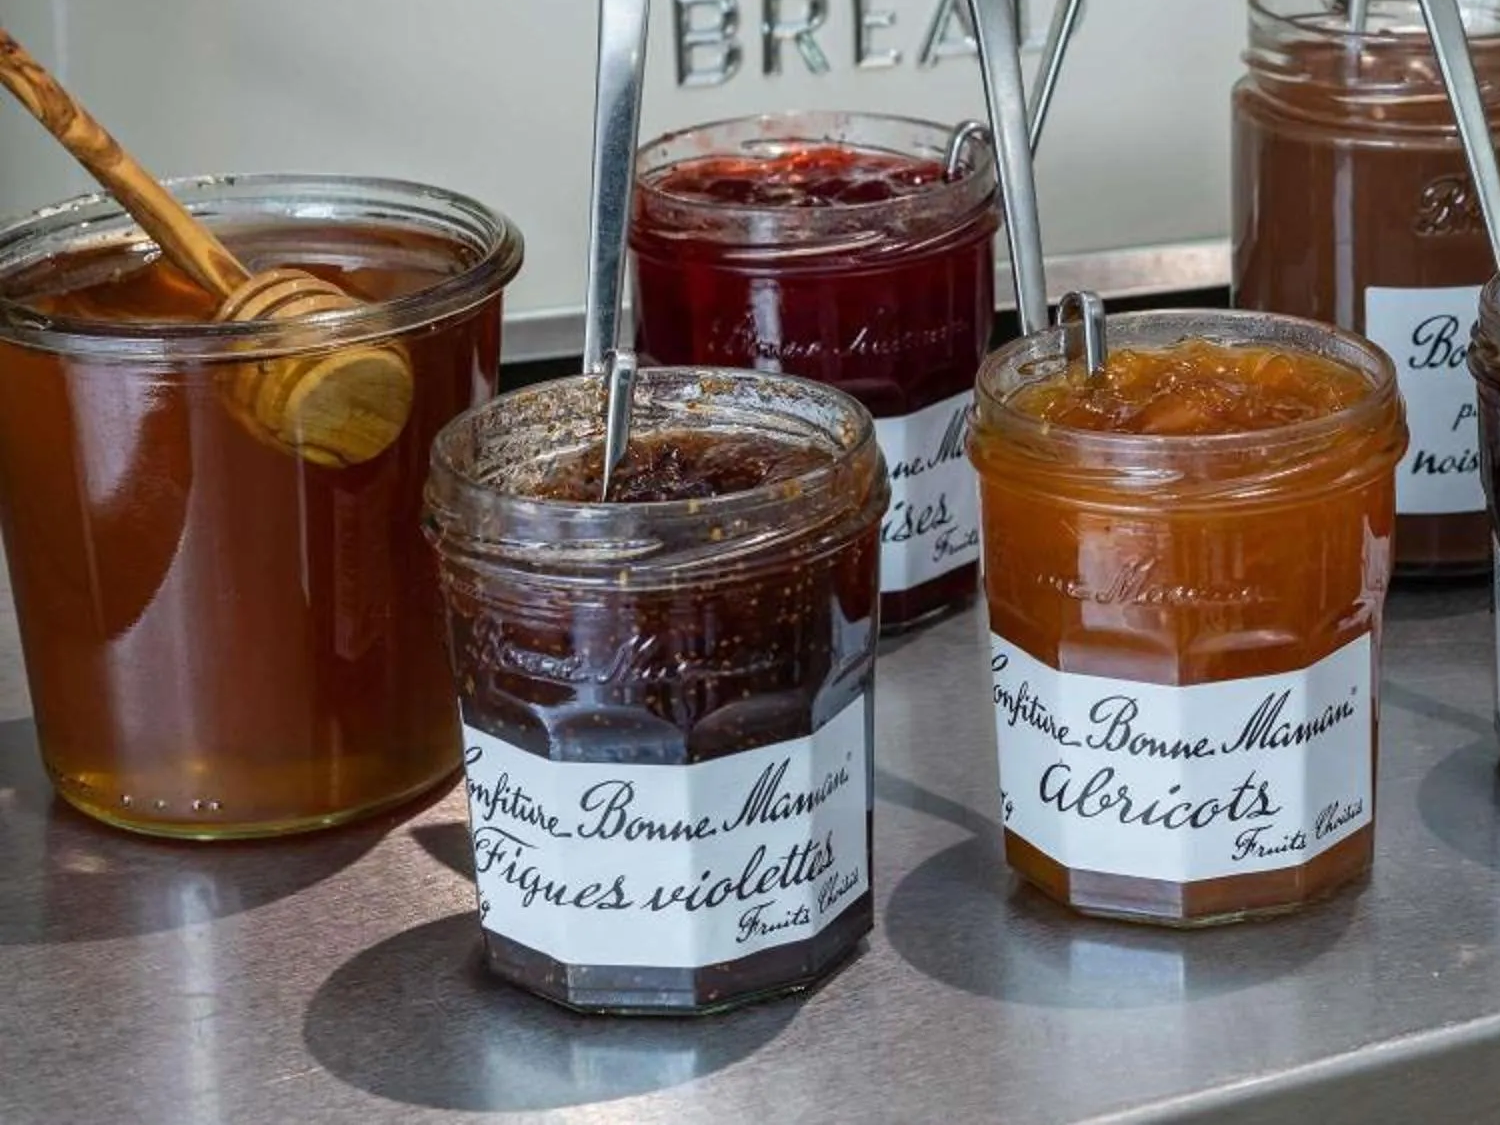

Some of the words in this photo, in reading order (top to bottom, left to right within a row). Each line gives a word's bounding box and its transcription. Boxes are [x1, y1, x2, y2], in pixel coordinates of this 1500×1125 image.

[1086, 695, 1215, 759] Bonne
[1221, 688, 1355, 754] Maman
[577, 780, 717, 842] Bonne
[722, 756, 852, 832] Maman
[475, 826, 634, 912] Figues
[640, 829, 836, 913] violettes
[1231, 824, 1308, 861] Fruits
[735, 898, 812, 944] Fruits
